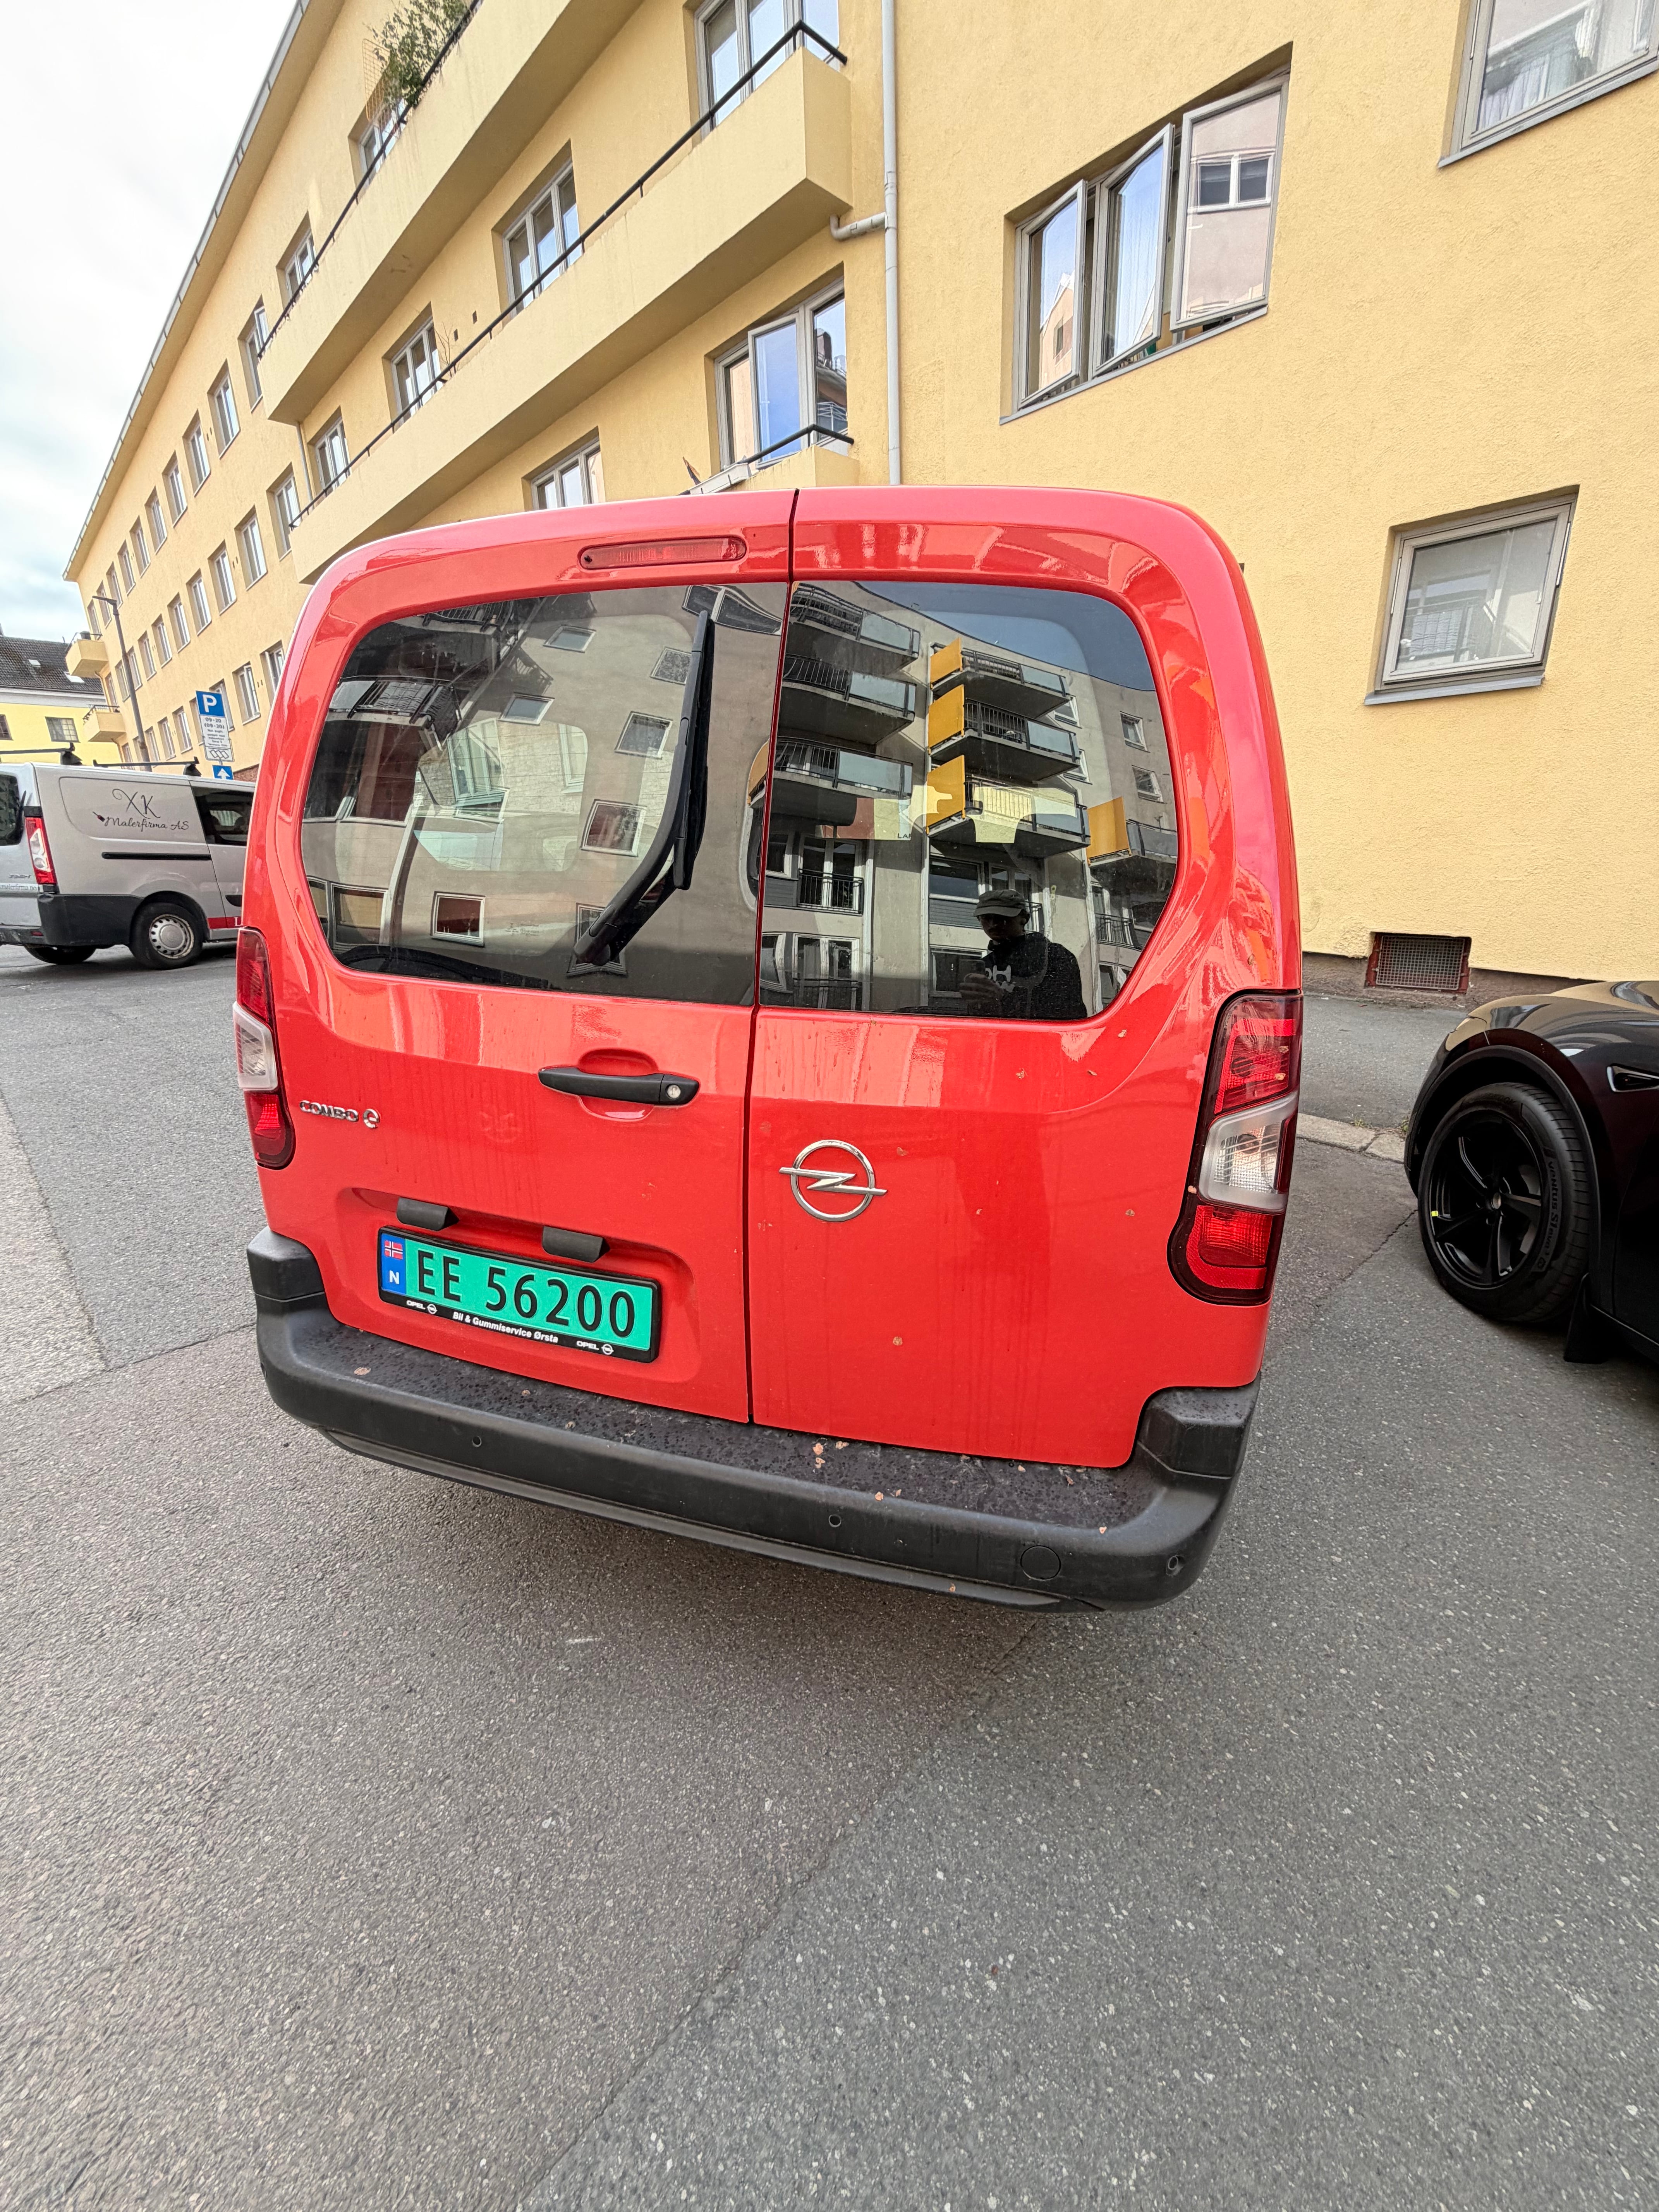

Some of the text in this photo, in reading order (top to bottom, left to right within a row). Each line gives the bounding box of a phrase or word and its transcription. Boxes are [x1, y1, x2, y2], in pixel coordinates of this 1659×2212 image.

[203, 694, 217, 713] P
[104, 816, 189, 832] Malerfirma AS
[300, 1100, 359, 1121] COMBO
[390, 1270, 400, 1285] N
[418, 1249, 635, 1338] EE 56200
[407, 1300, 426, 1311] OPEL
[453, 1312, 463, 1321] Bil
[472, 1316, 532, 1338] Gummiservice
[534, 1329, 558, 1343] Ørsta
[577, 1340, 599, 1351] OPEL
